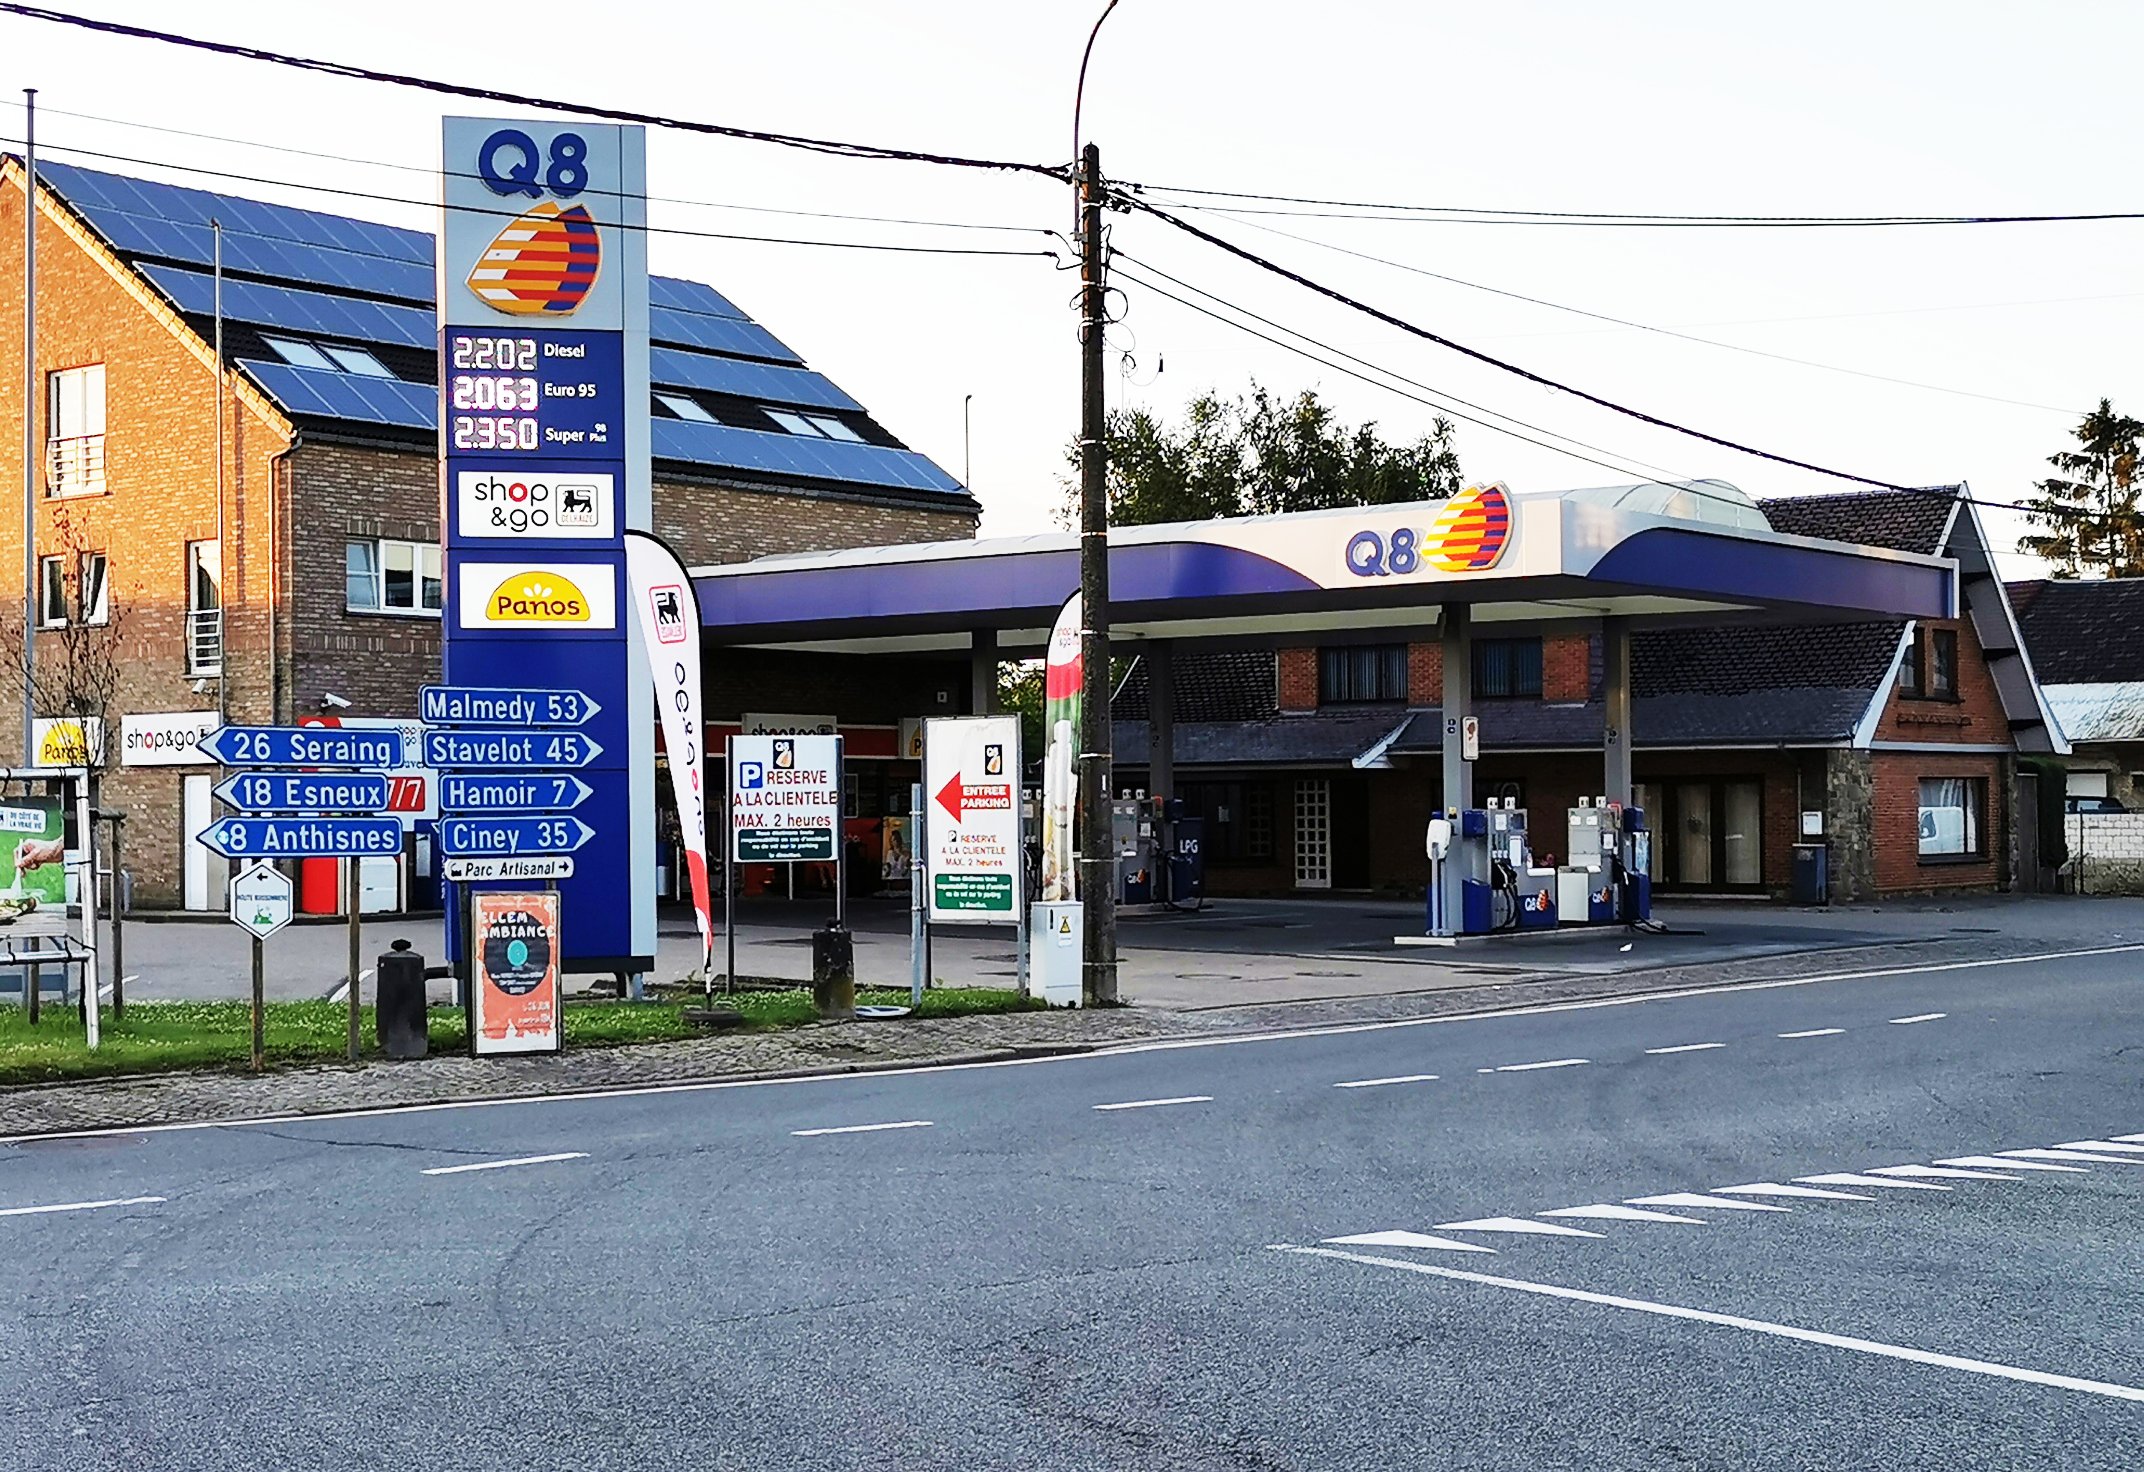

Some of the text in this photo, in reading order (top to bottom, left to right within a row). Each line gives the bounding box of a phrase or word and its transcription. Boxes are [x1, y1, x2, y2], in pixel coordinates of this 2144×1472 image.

[478, 129, 588, 198] Q8
[544, 344, 585, 358] Diesel
[545, 384, 576, 398] Euro
[578, 384, 596, 398] 95
[545, 428, 585, 445] Super
[475, 476, 549, 506] shop
[491, 507, 549, 533] &go
[1345, 528, 1416, 577] Q8
[498, 596, 580, 616] Panos
[427, 693, 578, 726] Malmedy 53
[127, 728, 195, 752] shop&go
[233, 733, 391, 767] 26 Seraing
[432, 736, 578, 763] Stavelot 45
[767, 770, 828, 785] RESERVE
[244, 779, 381, 805] 18 Esneux
[450, 780, 567, 806] Hamoir 7
[746, 792, 763, 806] LA
[765, 791, 838, 806] CLIENTELE
[962, 786, 1007, 796] ENTREE
[960, 797, 1010, 808] PARKING
[734, 813, 831, 828] MAX. 2 heures
[230, 823, 395, 851] 8 Anthisnes
[453, 822, 568, 853] Ciney 35
[961, 835, 997, 843] RESERVE
[1180, 839, 1199, 853] LPG
[465, 861, 555, 877] Parc Artisanal
[968, 858, 972, 866] 2
[976, 859, 1003, 867] heures
